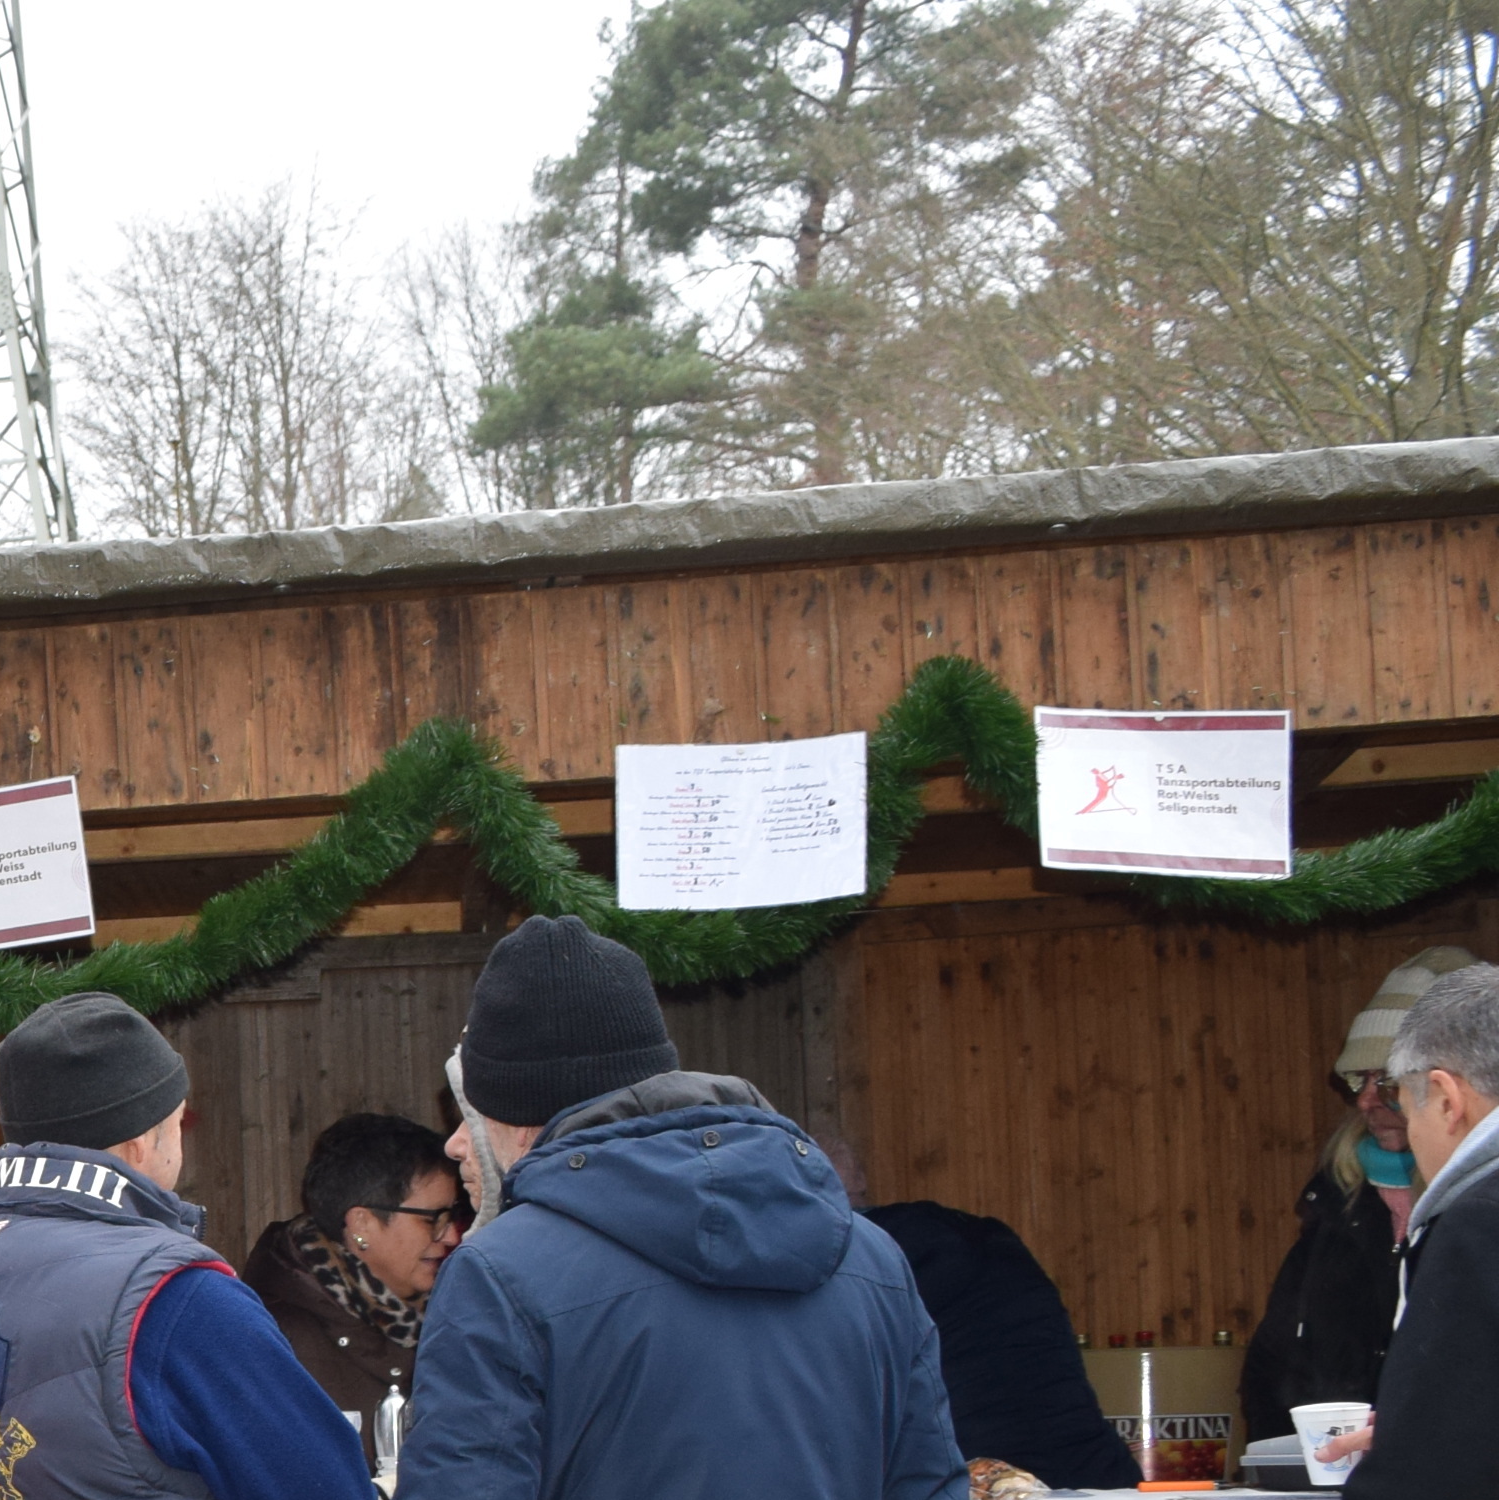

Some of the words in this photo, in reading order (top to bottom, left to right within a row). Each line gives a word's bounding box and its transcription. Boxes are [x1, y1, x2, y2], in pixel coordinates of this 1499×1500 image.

[1156, 776, 1282, 790] Tanzsportabteilung
[1157, 789, 1220, 801] Rot-Weiss
[1157, 801, 1238, 815] Seligenstadt
[1110, 1417, 1231, 1440] RAKTINA
